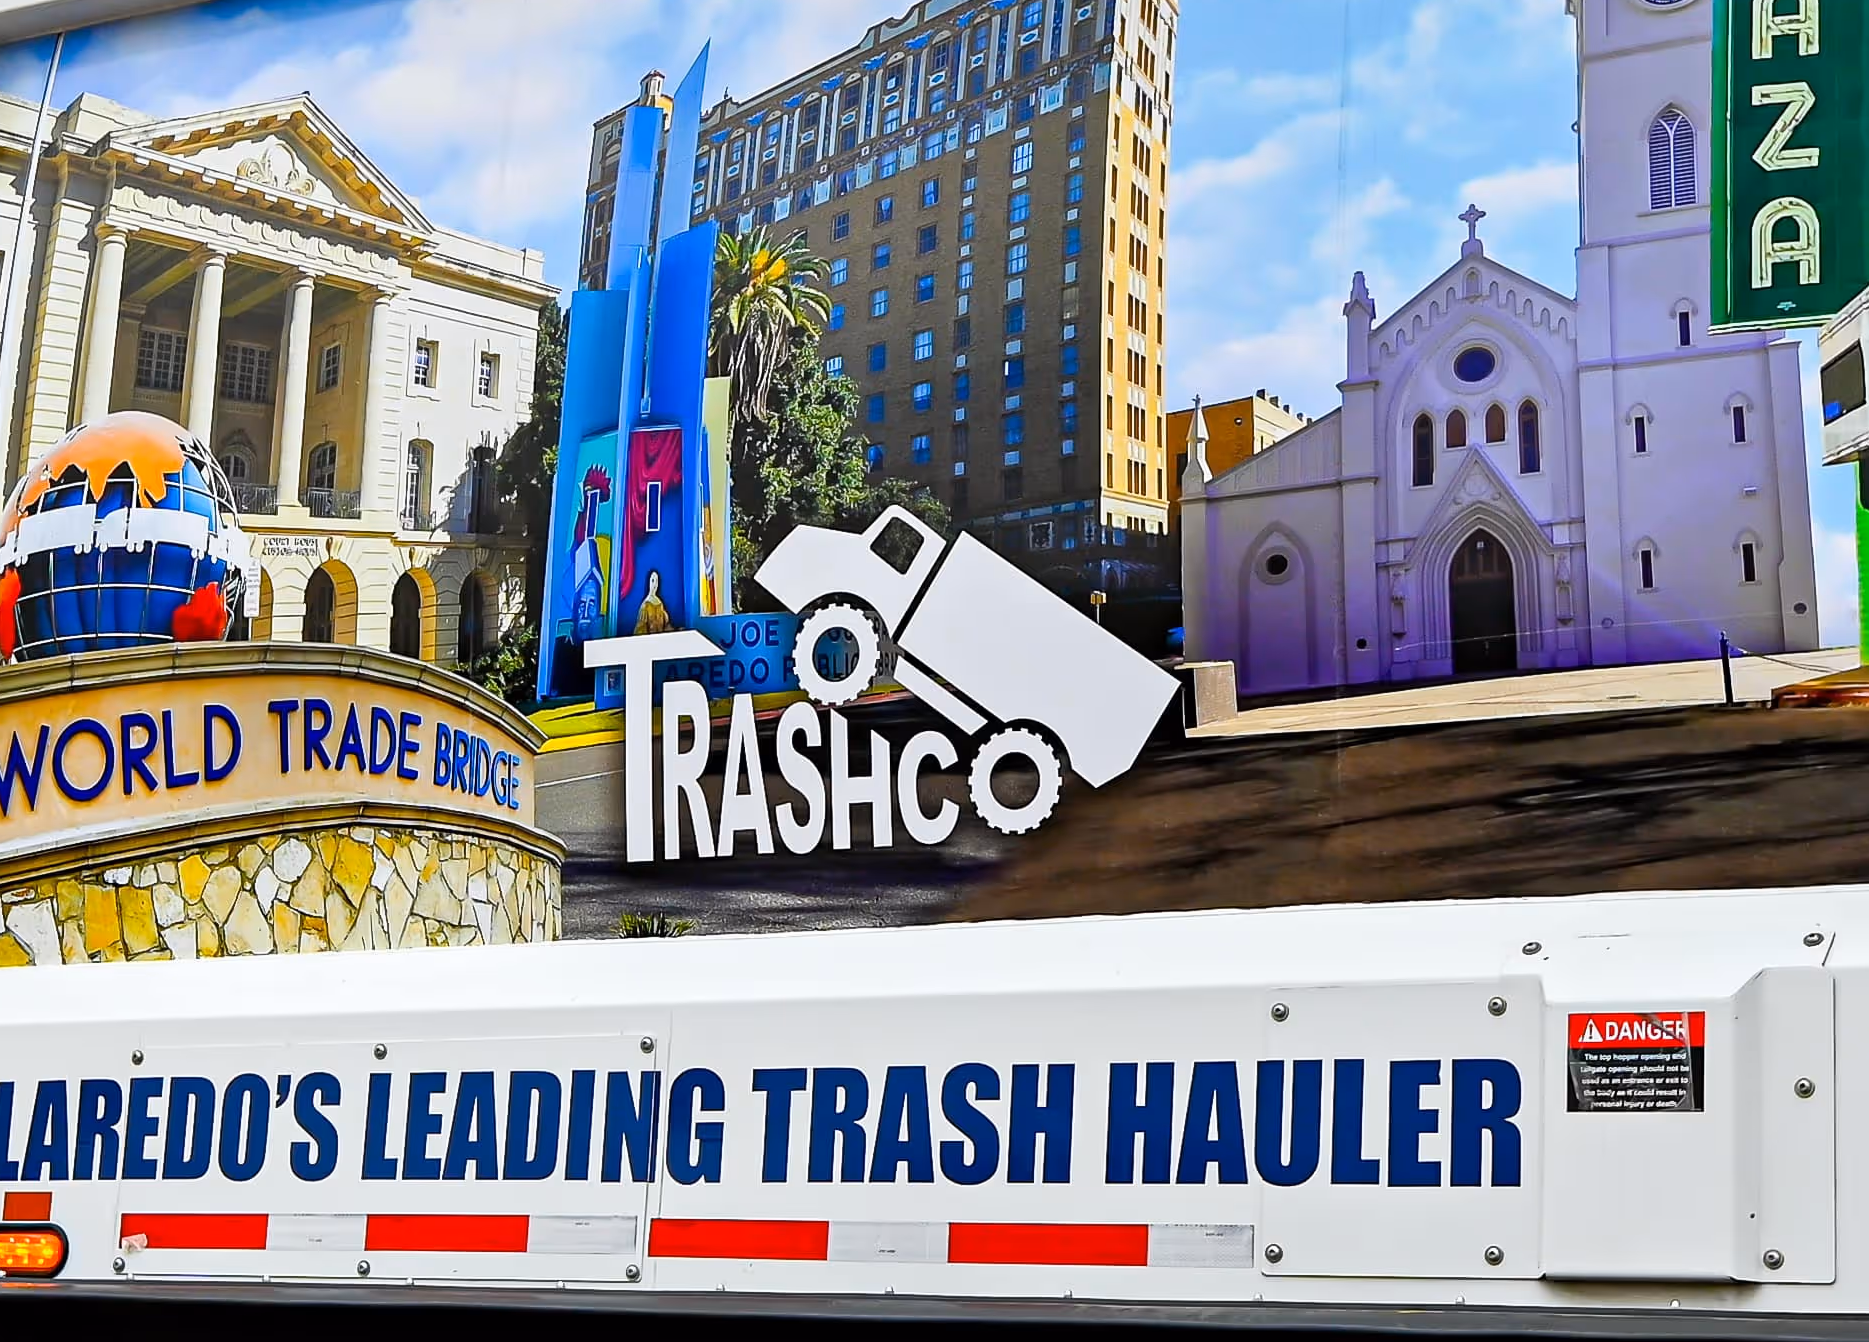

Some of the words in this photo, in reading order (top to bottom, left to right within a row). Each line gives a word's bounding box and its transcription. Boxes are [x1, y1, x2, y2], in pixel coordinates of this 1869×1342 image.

[720, 619, 779, 648] JOE
[665, 657, 770, 688] AREDO
[269, 697, 421, 781] TRADE
[433, 722, 521, 811] BRIDGE
[584, 630, 1064, 863] TRASHCO
[1605, 1020, 1687, 1041] DANGER
[360, 1068, 726, 1185] LEADING
[751, 1062, 1078, 1187] TRASH
[1104, 1058, 1522, 1188] HAULER
